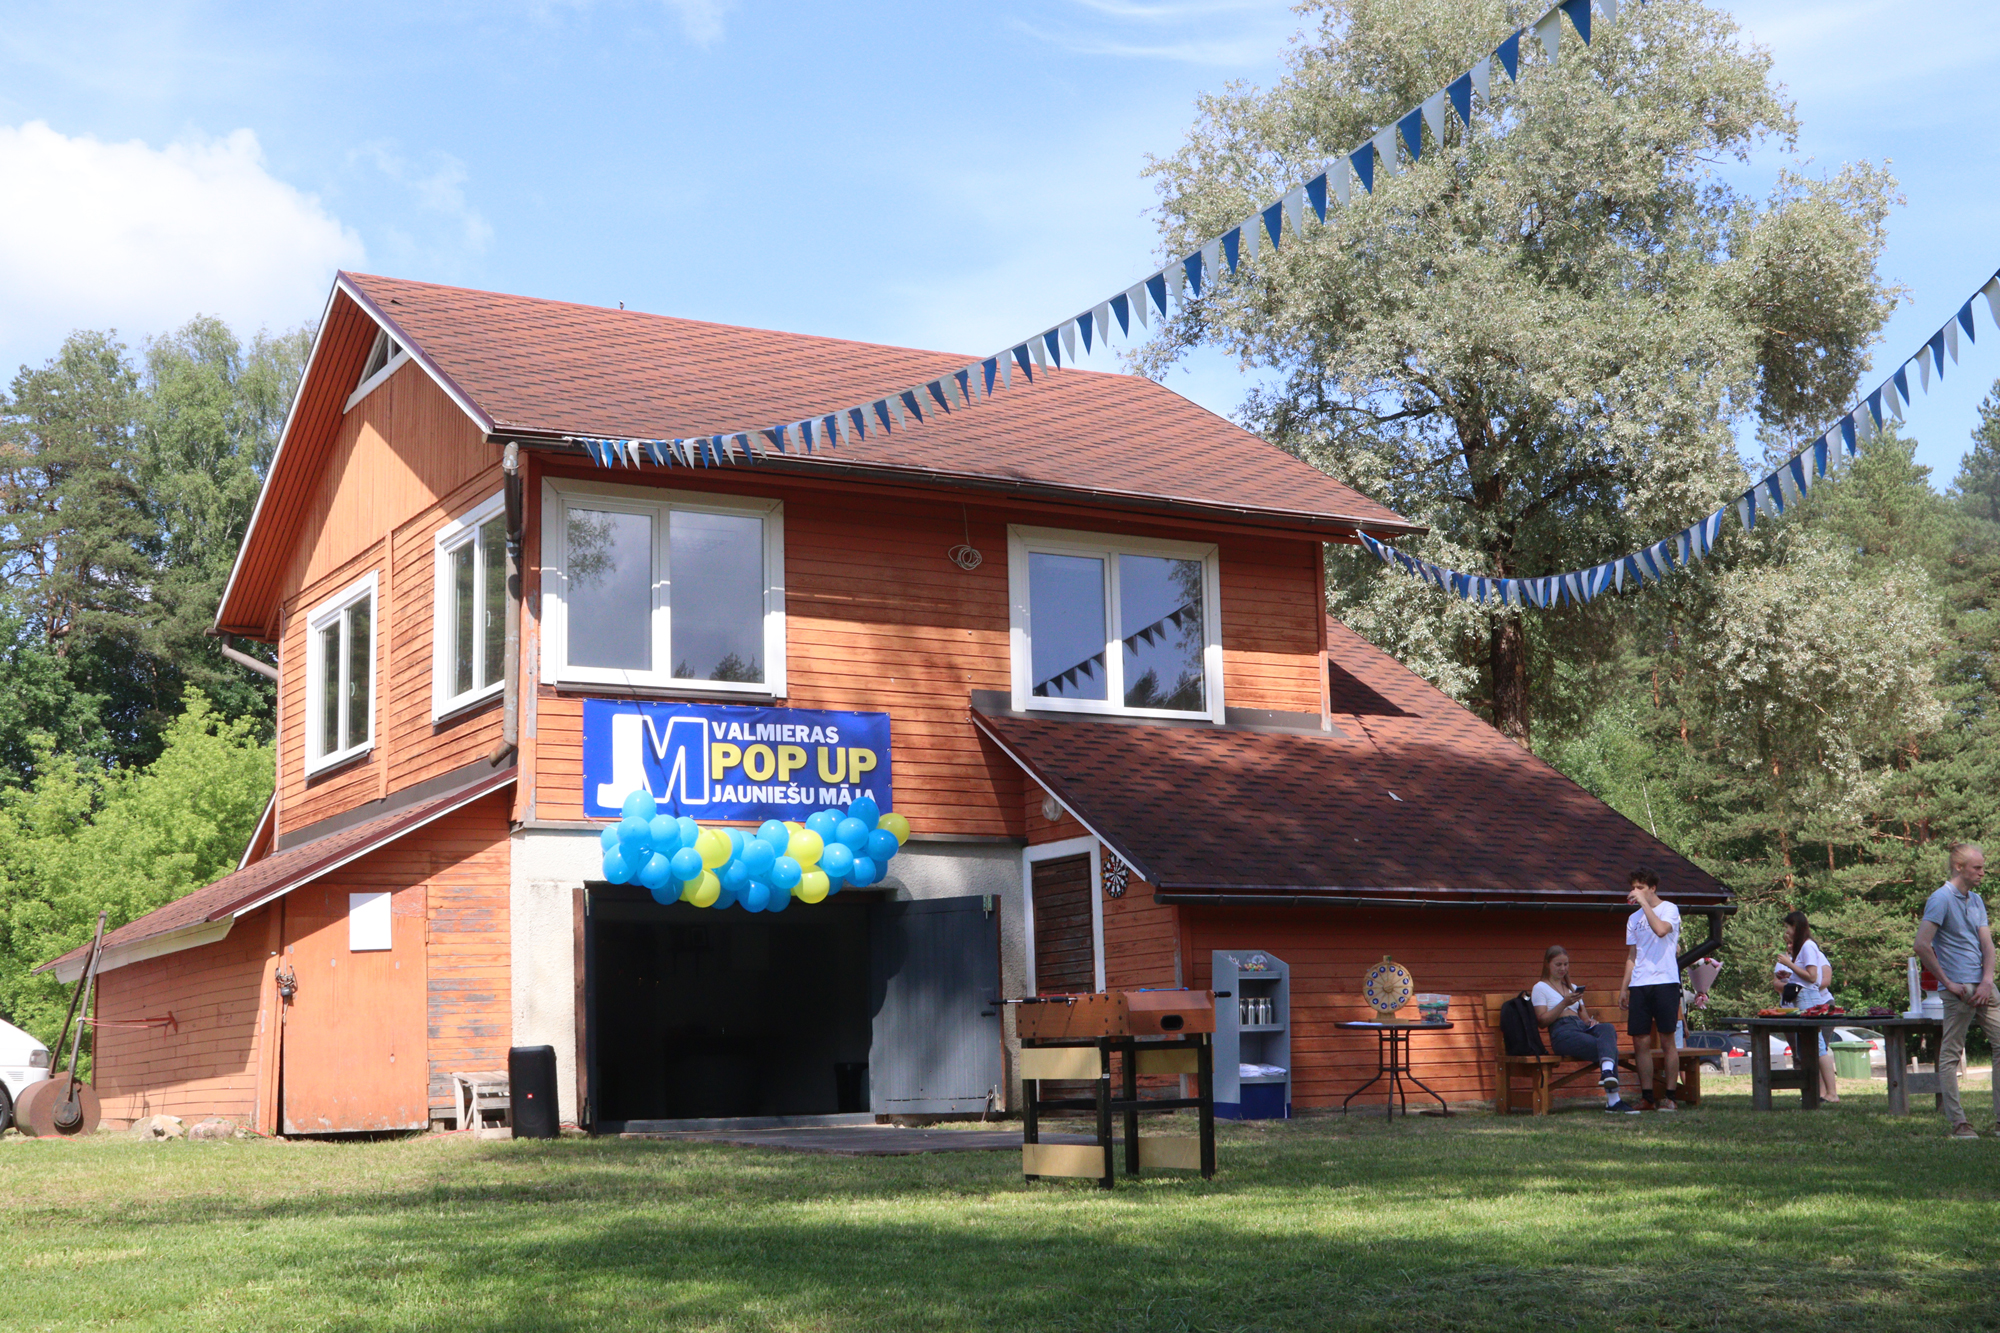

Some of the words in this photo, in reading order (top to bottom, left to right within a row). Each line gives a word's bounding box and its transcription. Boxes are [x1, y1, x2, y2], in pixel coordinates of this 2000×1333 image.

[711, 721, 839, 744] VALMIERAS
[711, 742, 808, 782] POP
[817, 746, 877, 784] UP
[712, 782, 815, 805] JAUNIEŠU
